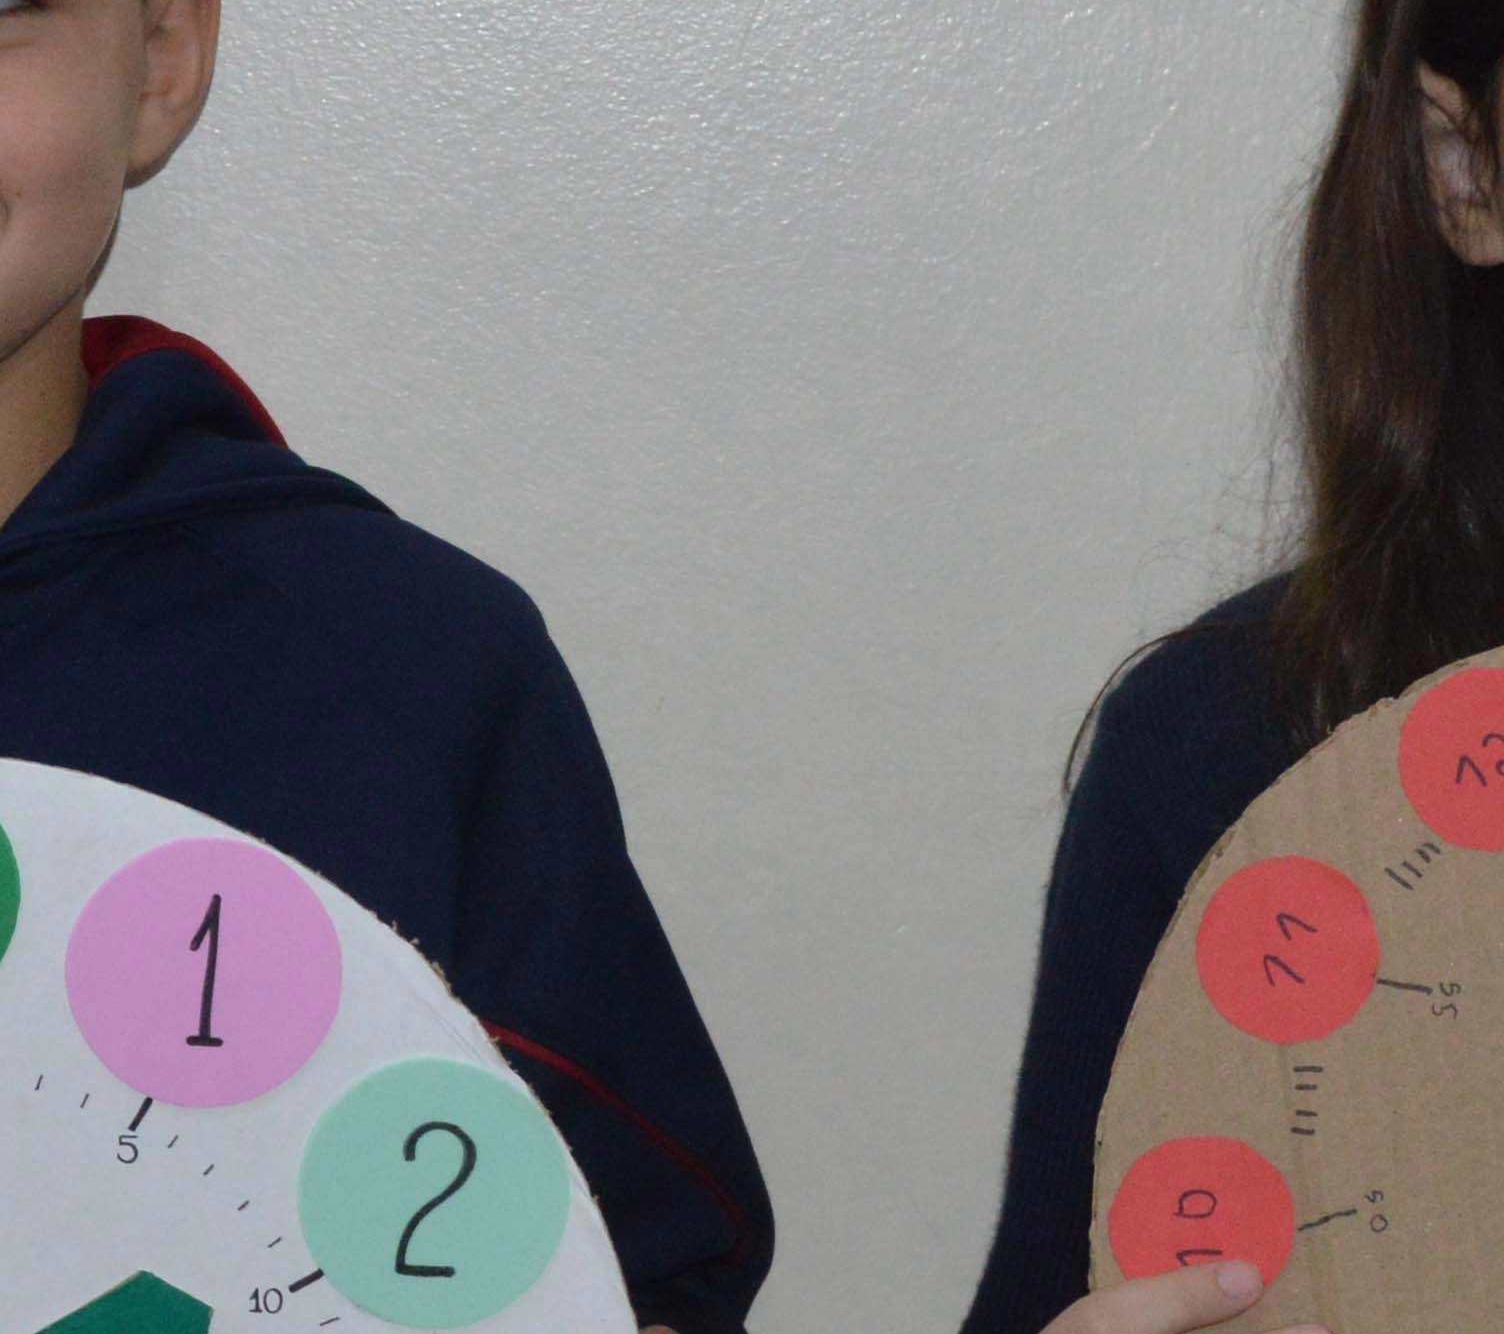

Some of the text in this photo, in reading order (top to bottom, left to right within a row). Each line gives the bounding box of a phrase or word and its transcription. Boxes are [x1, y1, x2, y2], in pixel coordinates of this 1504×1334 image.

[185, 893, 224, 1048] 1
[1262, 912, 1317, 986] 11
[1431, 982, 1462, 1019] 55
[116, 1134, 139, 1165] 5
[394, 1121, 477, 1278] 2
[1364, 1189, 1389, 1234] 50
[250, 1287, 284, 1314] 10
